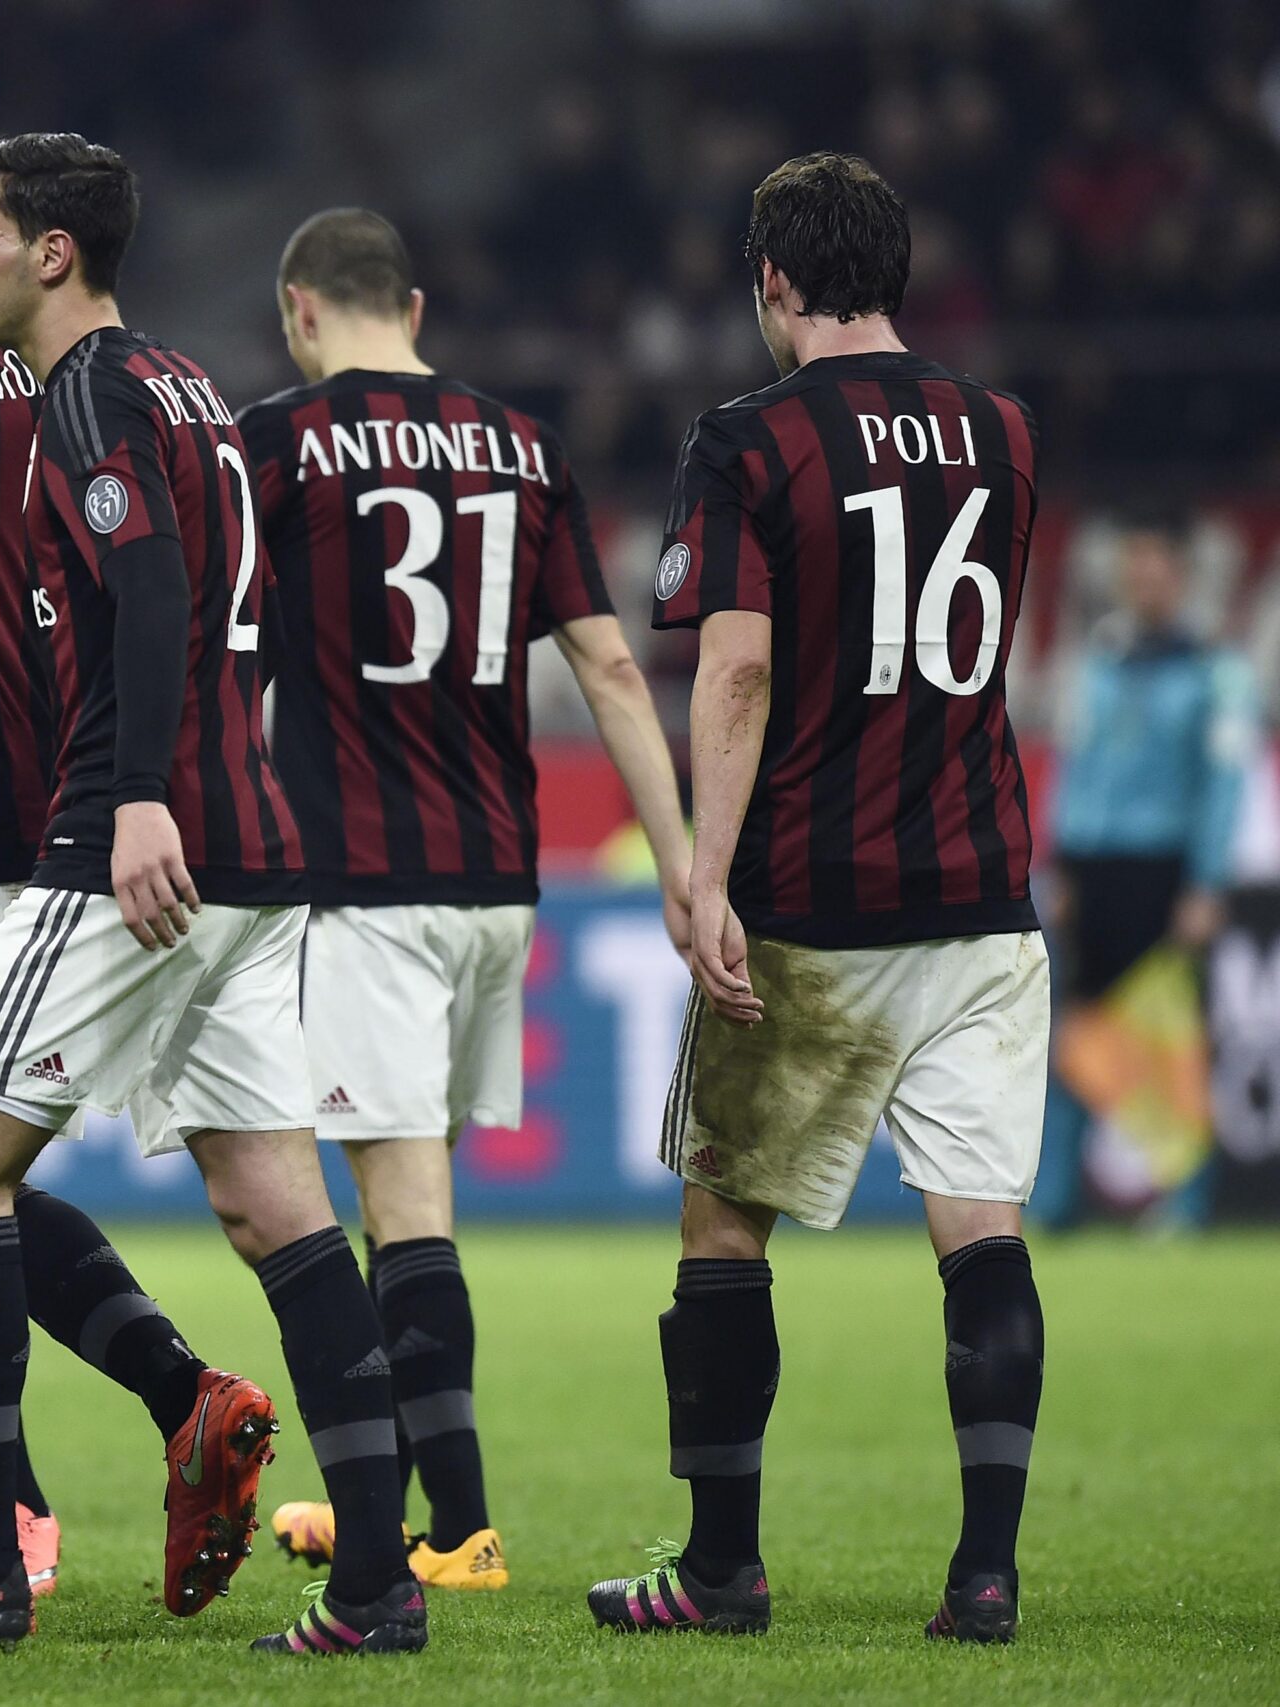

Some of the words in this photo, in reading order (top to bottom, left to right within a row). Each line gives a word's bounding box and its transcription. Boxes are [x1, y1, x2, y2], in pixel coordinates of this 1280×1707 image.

[144, 373, 197, 426] DE
[297, 419, 550, 487] ANTONELLI
[857, 414, 976, 466] POLI
[101, 501, 112, 517] 7
[217, 442, 259, 653] 2
[357, 487, 517, 685] 31
[668, 570, 676, 585] 7
[844, 485, 1002, 696] 16
[25, 1066, 70, 1085] adidas
